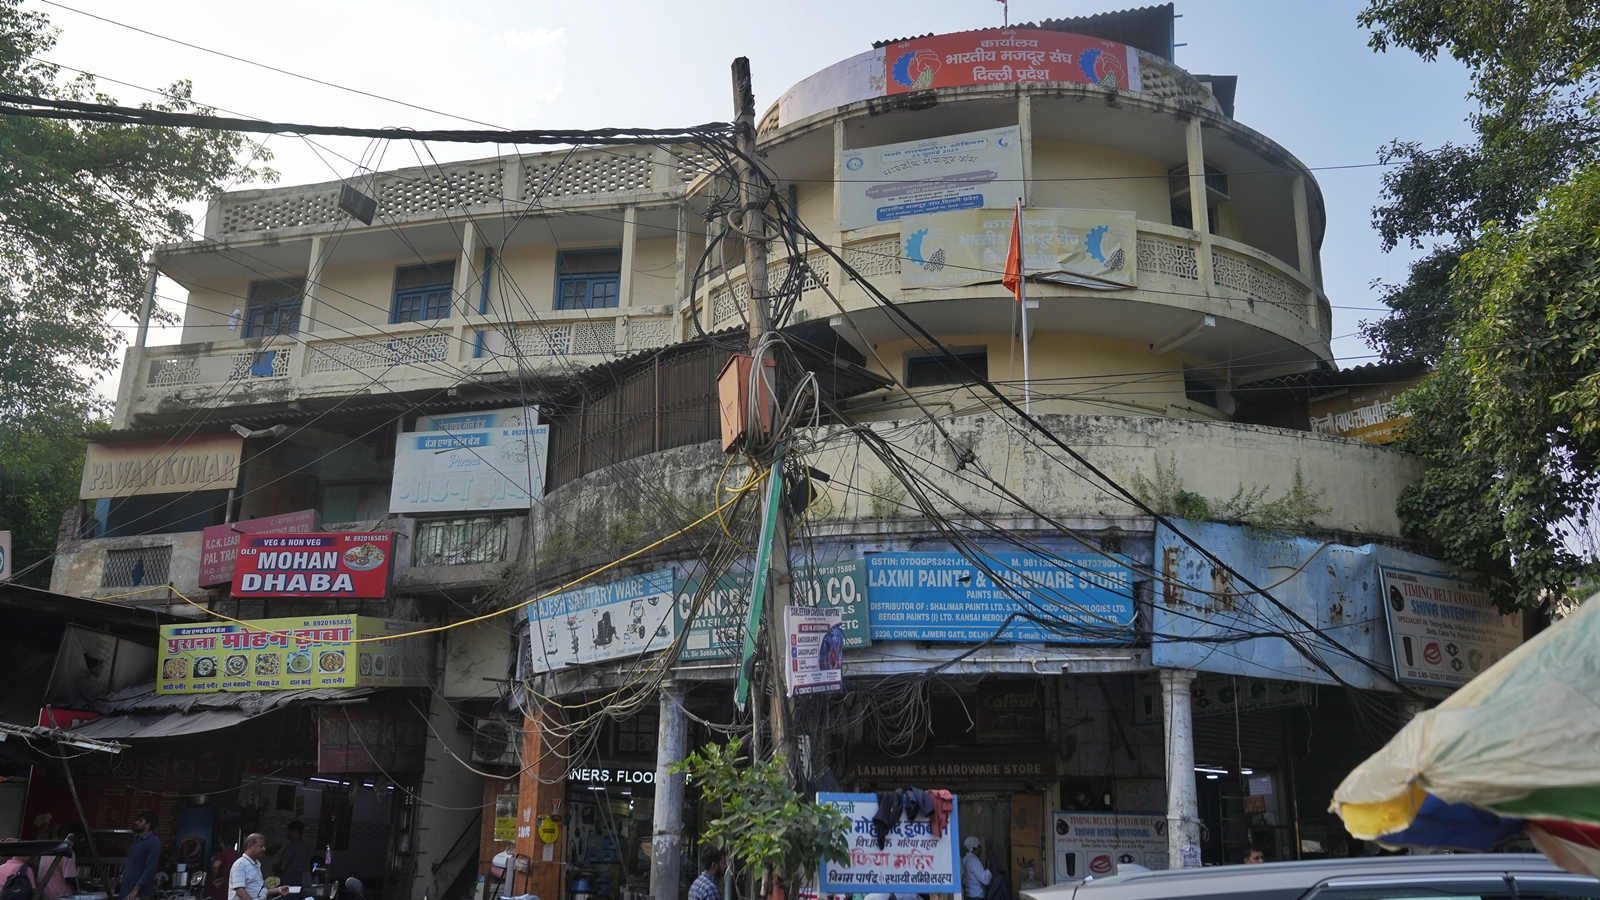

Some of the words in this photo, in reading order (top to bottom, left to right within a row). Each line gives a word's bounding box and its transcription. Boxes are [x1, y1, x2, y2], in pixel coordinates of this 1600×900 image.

[980, 36, 1038, 48] कार्यालय
[946, 46, 996, 64] भारतीय
[1001, 49, 1045, 66] मजदूर
[1049, 48, 1072, 64] संघ
[972, 66, 1013, 81] दिल्ली
[1016, 68, 1050, 82] प्रदेश
[958, 230, 1006, 246] भारतीय
[1056, 230, 1080, 246] संघ
[425, 438, 436, 448] वेज
[438, 437, 452, 447] एण्ड
[454, 434, 466, 446] नॉन
[468, 436, 480, 445] वेज
[89, 458, 160, 491] PAWAN
[161, 453, 235, 486] KUMAR
[204, 552, 218, 565] PAL
[258, 552, 338, 570] MOHAN
[872, 558, 898, 566] GSTIN:
[1012, 558, 1021, 567] M.
[241, 574, 354, 592] DHABA
[869, 569, 914, 588] LAXMI
[918, 569, 972, 588] PAINTS
[976, 570, 986, 588] &
[992, 570, 1074, 589] HARDWARE
[1079, 571, 1128, 590] STORE
[1386, 571, 1398, 580] VIKAS
[1398, 574, 1418, 583] AGGARWAL
[827, 576, 862, 606] CO.
[966, 590, 992, 600] PAINTS
[1402, 582, 1432, 600] TIMING
[1434, 588, 1453, 602] BELT
[533, 597, 566, 618] RAJESH
[568, 586, 614, 612] SANITARY
[614, 581, 645, 600] WARE
[825, 608, 840, 616] HOSPITAL
[870, 602, 914, 611] DISTRIBUTOR
[916, 602, 925, 611] OF
[930, 602, 964, 611] SHALIMAR
[966, 602, 989, 611] PAINTS
[990, 603, 1005, 612] LTD.
[1042, 604, 1058, 612] CICO
[1112, 605, 1127, 613] LTD.
[1411, 600, 1438, 618] SHIVA
[1440, 604, 1505, 627] INTERNATIONAL
[312, 618, 352, 627] 8920165835
[878, 613, 905, 621] BERGER
[906, 613, 930, 621] PAINTS
[940, 613, 954, 621] LTD.
[956, 613, 980, 621] KANSAI
[1397, 615, 1422, 626] SPECIALIST
[1430, 620, 1443, 630] Timing
[1444, 622, 1454, 632] Belts,
[1454, 624, 1467, 632] V-Belts
[167, 636, 218, 654] पुराना
[222, 627, 289, 650] मोहन
[875, 630, 892, 639] 5236,
[894, 630, 920, 640] CHOWK,
[948, 631, 966, 640] GATE,
[1018, 632, 1040, 640] E-mail:
[1426, 628, 1438, 637] Belts,
[1457, 632, 1471, 641] Flexible
[858, 764, 888, 775] LAXMI
[890, 764, 926, 775] PAINTS
[929, 764, 936, 775] &
[938, 764, 1000, 775] HARDWARE
[1004, 764, 1041, 774] STORE
[1070, 816, 1092, 825] TIMING
[1093, 816, 1107, 825] BELT
[1108, 816, 1139, 825] CONVEYOR
[1140, 818, 1154, 826] BELT
[1074, 827, 1096, 836] SHIVA
[1097, 828, 1150, 838] INTERNATIONAL
[920, 839, 940, 850] महल
[828, 870, 853, 883] निगम
[856, 870, 878, 884] पार्षद
[886, 870, 910, 884] स्थायी
[930, 872, 952, 884] सदस्य
